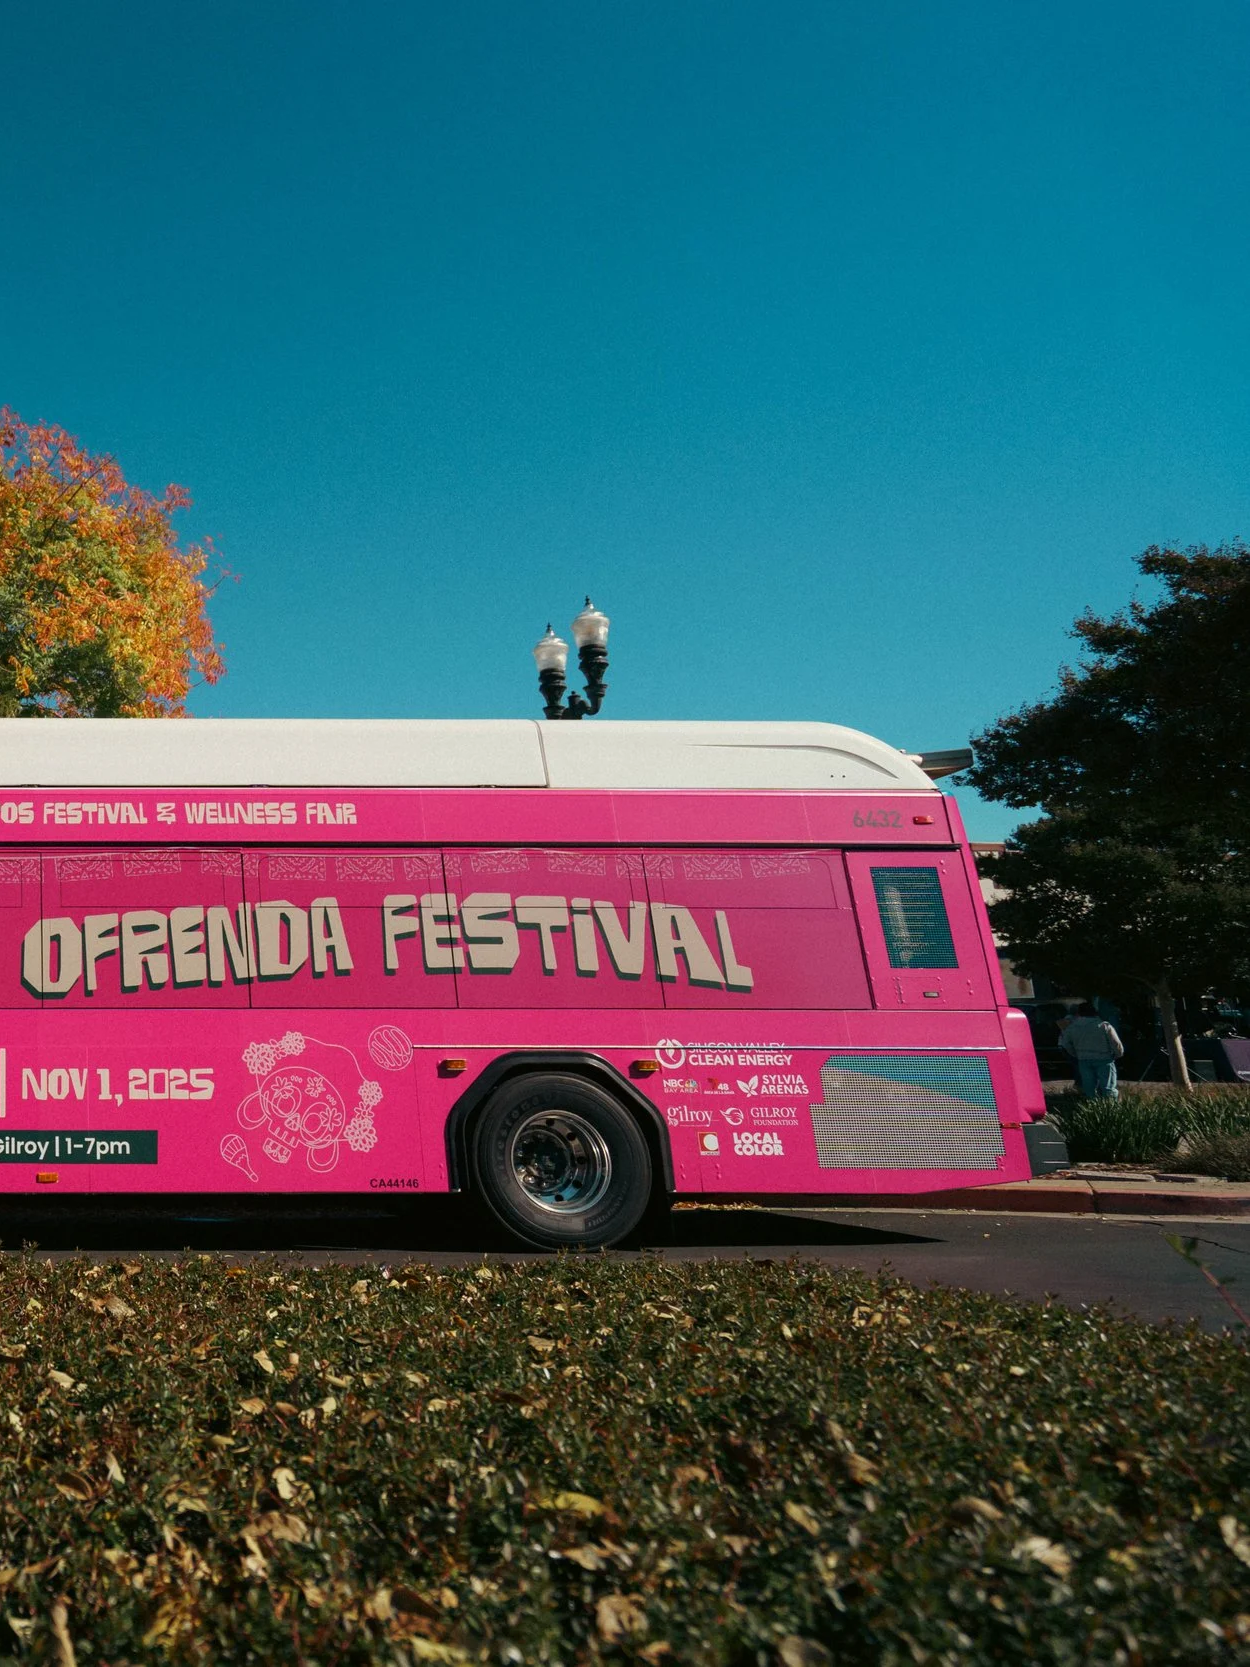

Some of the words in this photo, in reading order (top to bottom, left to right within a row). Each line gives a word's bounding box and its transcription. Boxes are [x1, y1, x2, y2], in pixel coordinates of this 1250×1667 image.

[185, 802, 298, 824] WELLNESS
[852, 810, 903, 828] 6432
[21, 897, 354, 998] OFRENDA
[689, 1054, 734, 1066] CLEAN
[738, 1054, 792, 1066] ENERGY
[21, 1067, 88, 1100] NOV
[663, 1079, 684, 1088] NBC
[762, 1074, 804, 1085] SYLVIA
[760, 1084, 809, 1095] ARENAS
[667, 1105, 714, 1127] gilroy
[751, 1107, 797, 1118] GILROY
[753, 1119, 799, 1127] FOUNDATION
[733, 1132, 782, 1144] LOCAL
[734, 1143, 785, 1156] COLOR
[370, 1178, 419, 1188] CA44146
